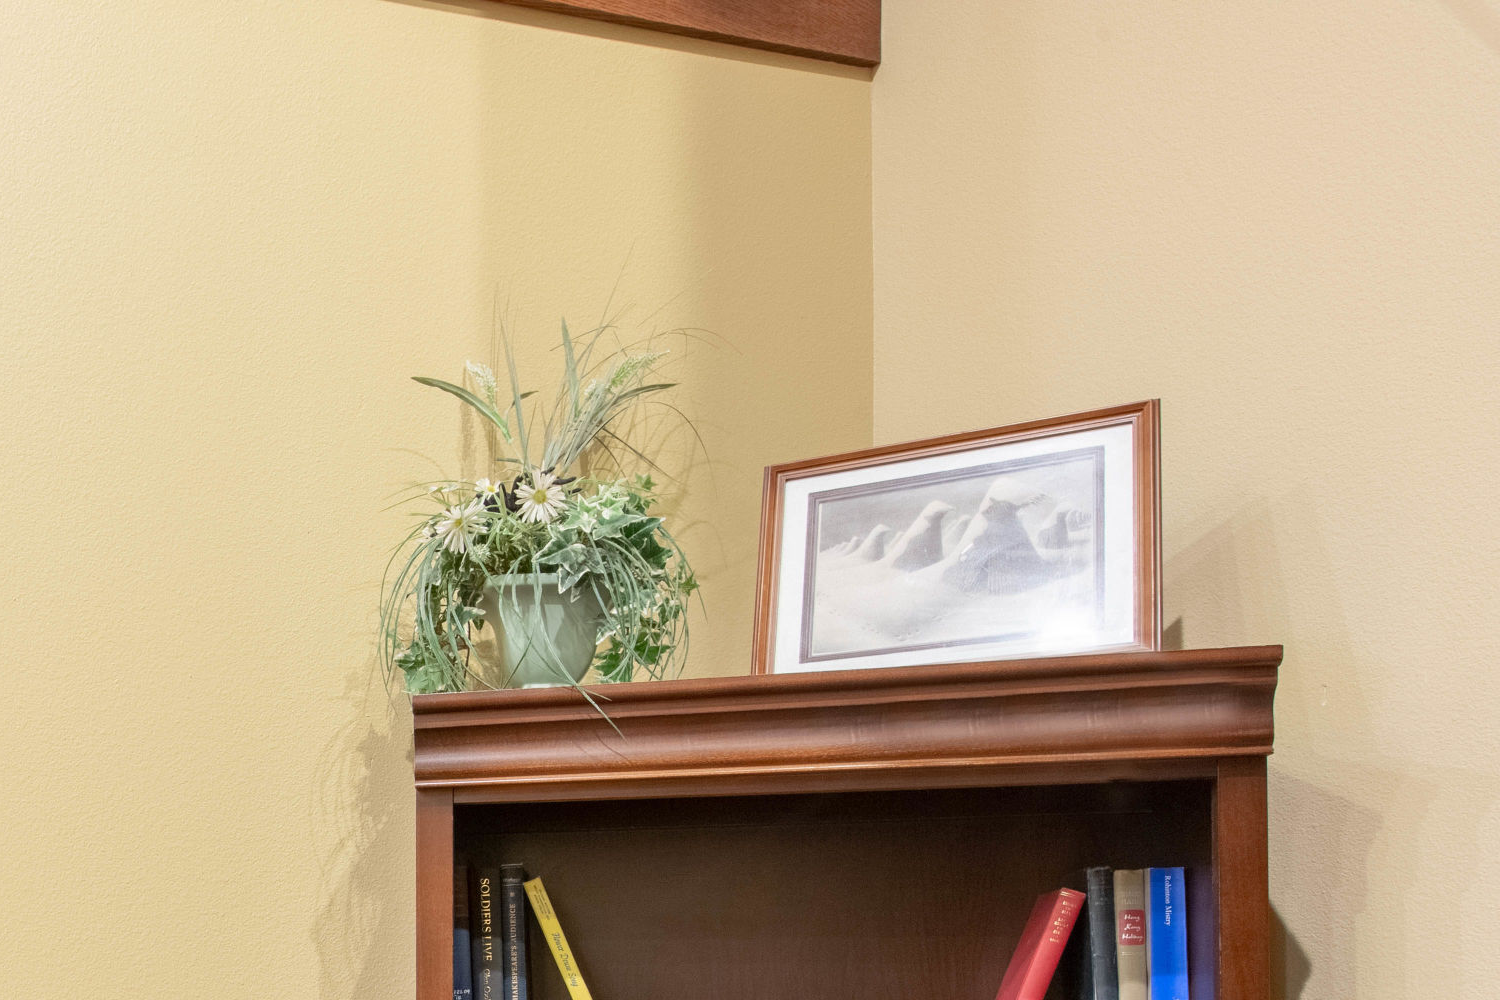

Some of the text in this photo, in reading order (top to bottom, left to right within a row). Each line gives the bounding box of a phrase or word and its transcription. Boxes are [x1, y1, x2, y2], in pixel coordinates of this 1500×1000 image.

[1164, 875, 1173, 926] Rohinton Mistry
[480, 878, 493, 961] SOLDIERS LIVE
[1124, 914, 1140, 922] Hong
[1124, 923, 1141, 932] Kong
